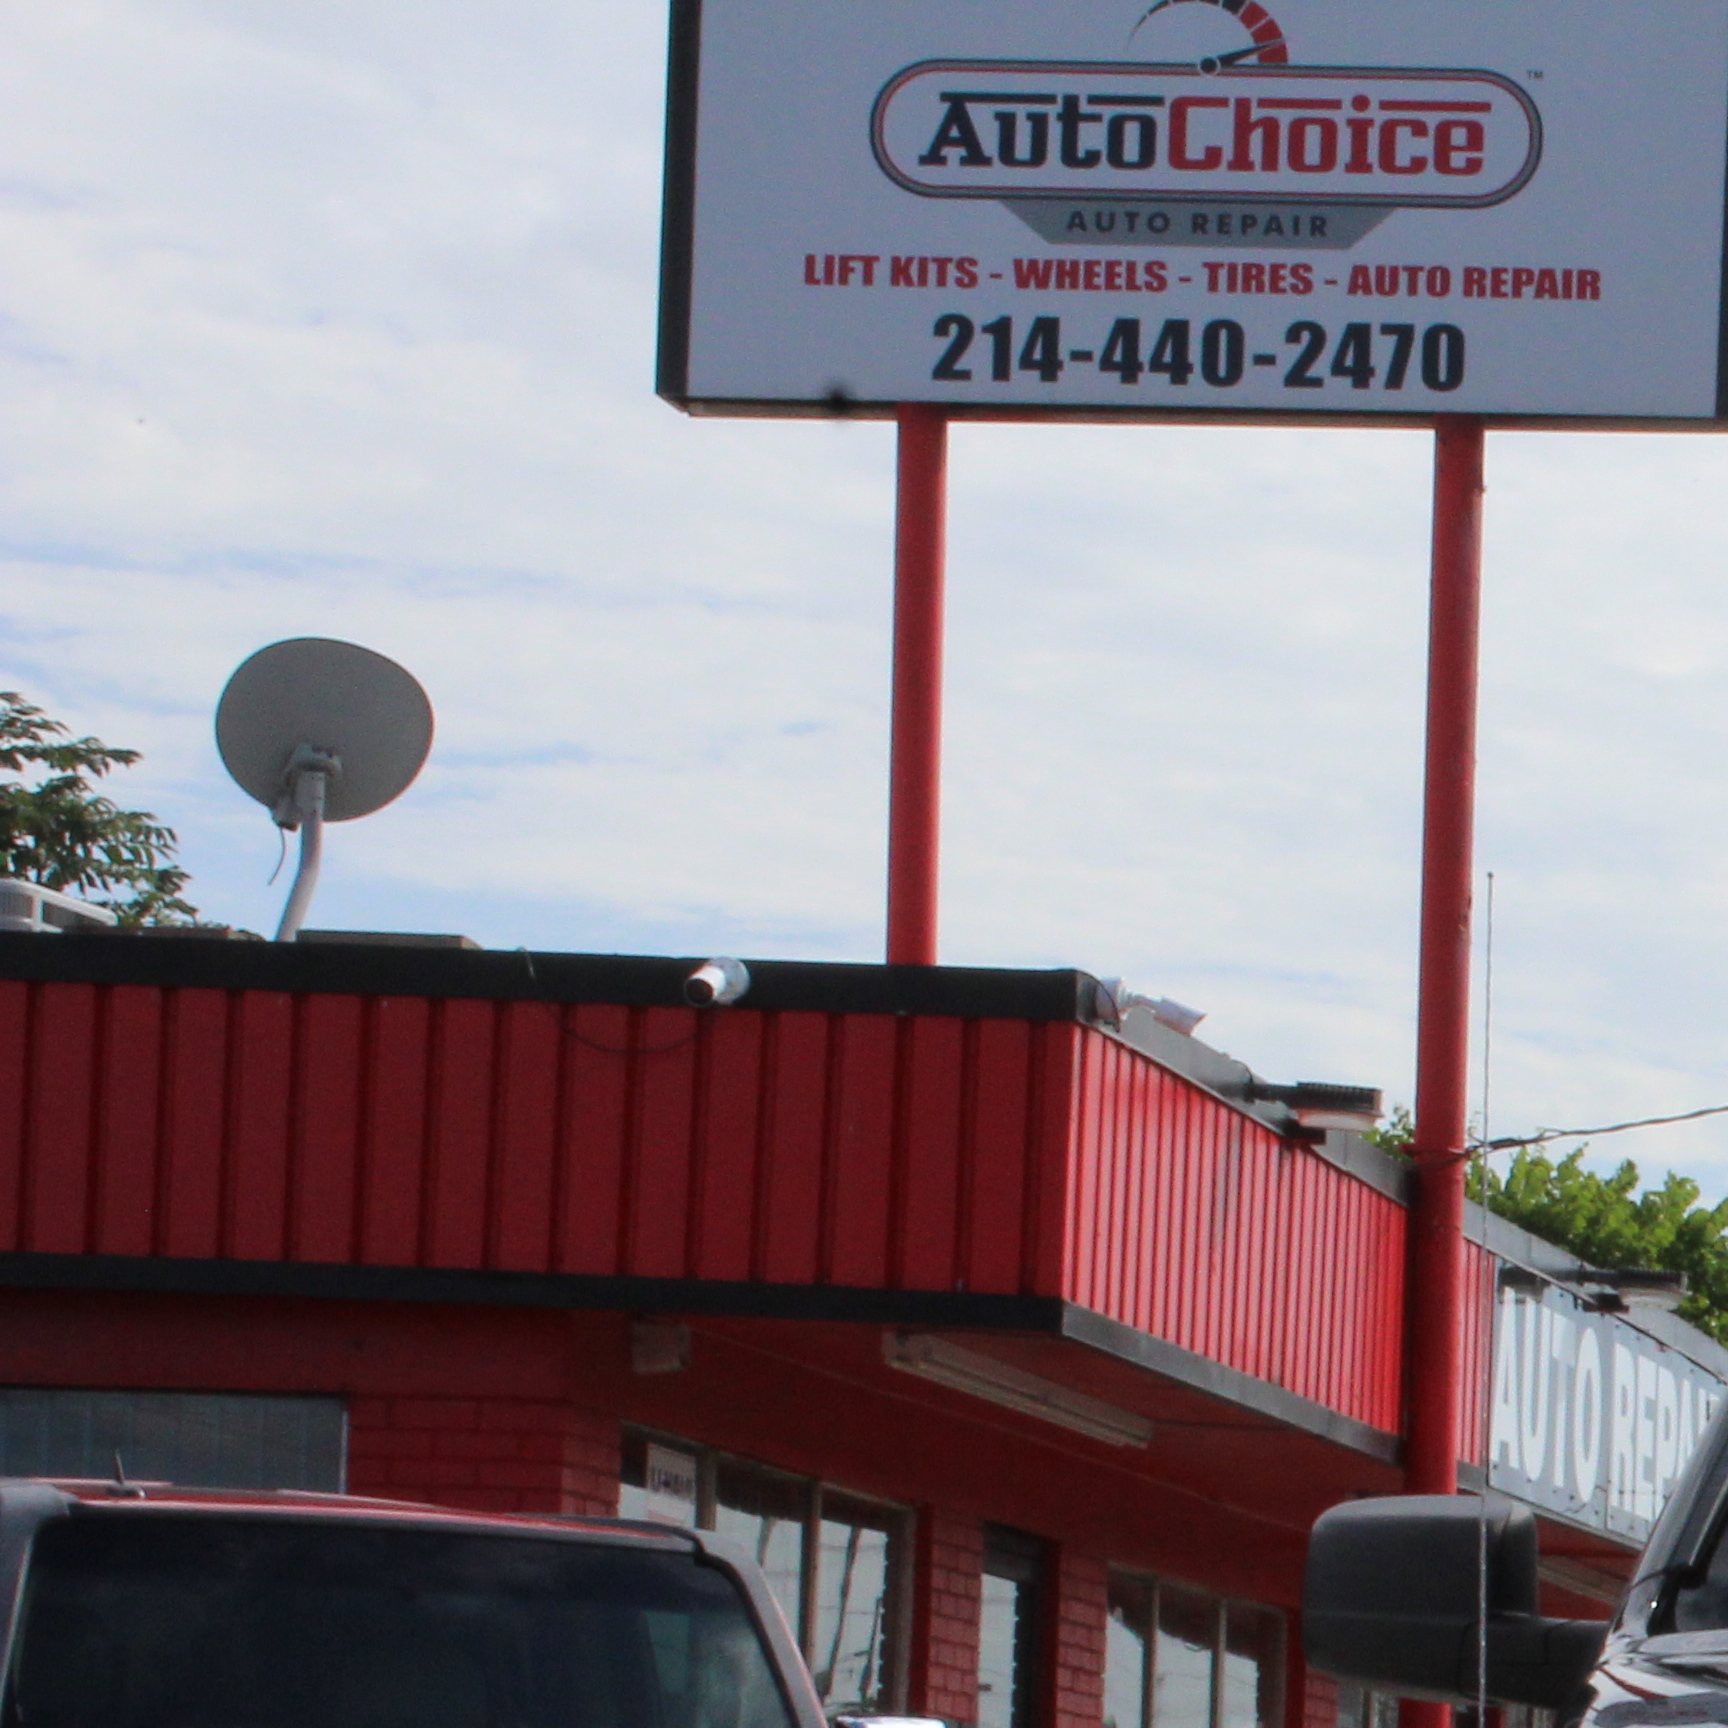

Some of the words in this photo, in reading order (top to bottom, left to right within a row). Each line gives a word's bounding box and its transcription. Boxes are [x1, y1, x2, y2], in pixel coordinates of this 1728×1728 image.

[918, 92, 1491, 176] AutoChoice
[1066, 210, 1171, 233] AUTO
[1191, 212, 1327, 237] REPAIR
[804, 254, 880, 286] LIFT
[889, 255, 980, 288] KITS
[1013, 258, 1169, 292] WHEELS
[1202, 262, 1314, 294] TIRES
[1347, 264, 1451, 297] AUTO
[1462, 266, 1601, 300] REPAIR
[931, 313, 1466, 392] 214-440-2470
[1491, 1286, 1600, 1502] AUTO
